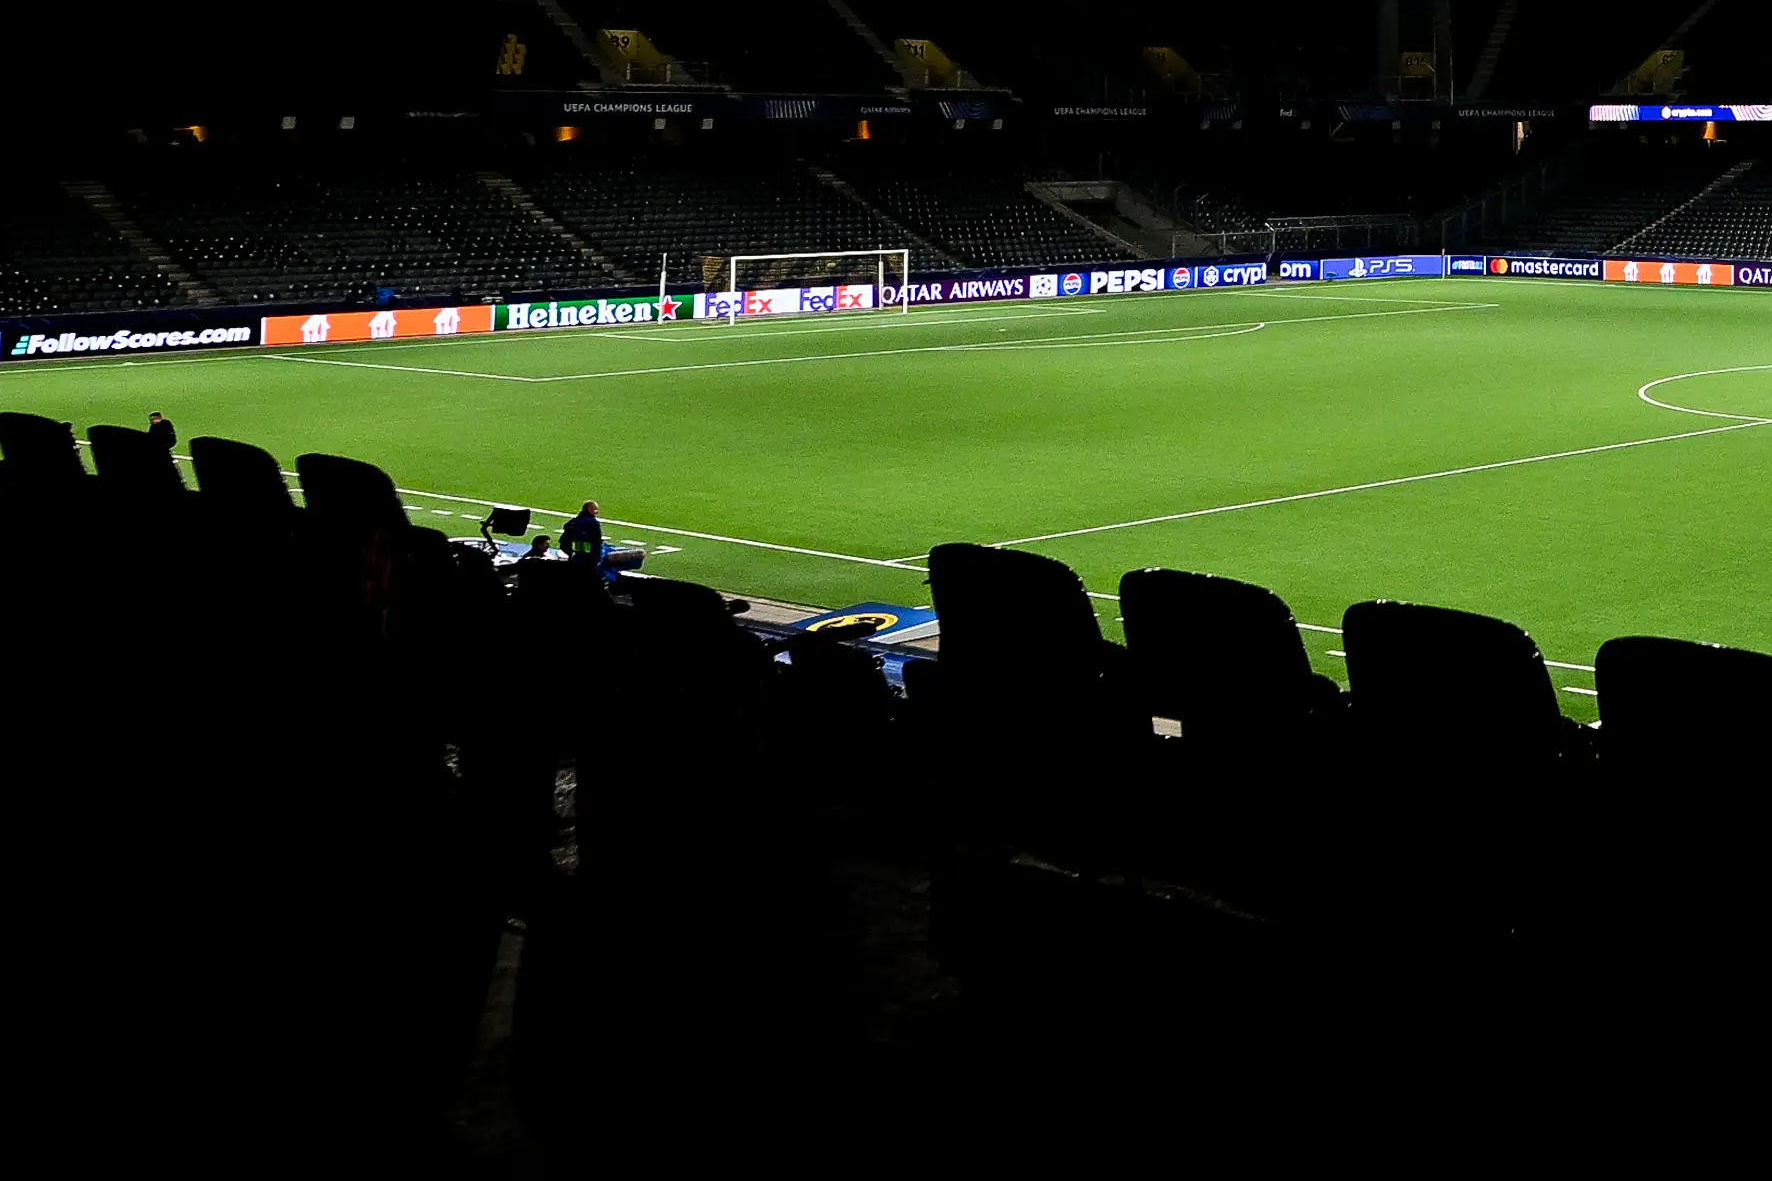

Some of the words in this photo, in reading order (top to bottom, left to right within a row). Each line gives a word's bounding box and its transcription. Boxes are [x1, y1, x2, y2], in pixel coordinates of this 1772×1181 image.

[563, 104, 591, 112] UEFA
[593, 103, 653, 113] CHAMPIONS
[655, 103, 693, 113] LEAGUE
[1054, 107, 1074, 115] UEFA
[1075, 107, 1118, 116] CHAMPIONS
[1120, 107, 1147, 115] LEAGUE
[1370, 259, 1414, 273] PS5
[1511, 259, 1599, 276] mastercard
[949, 279, 1024, 300] AIRWAYS
[1090, 269, 1165, 294] PEPSI
[705, 290, 773, 317] FedEx
[799, 283, 863, 311] FedEx
[506, 299, 653, 330] Heineken
[26, 327, 252, 355] FollowScores.com
